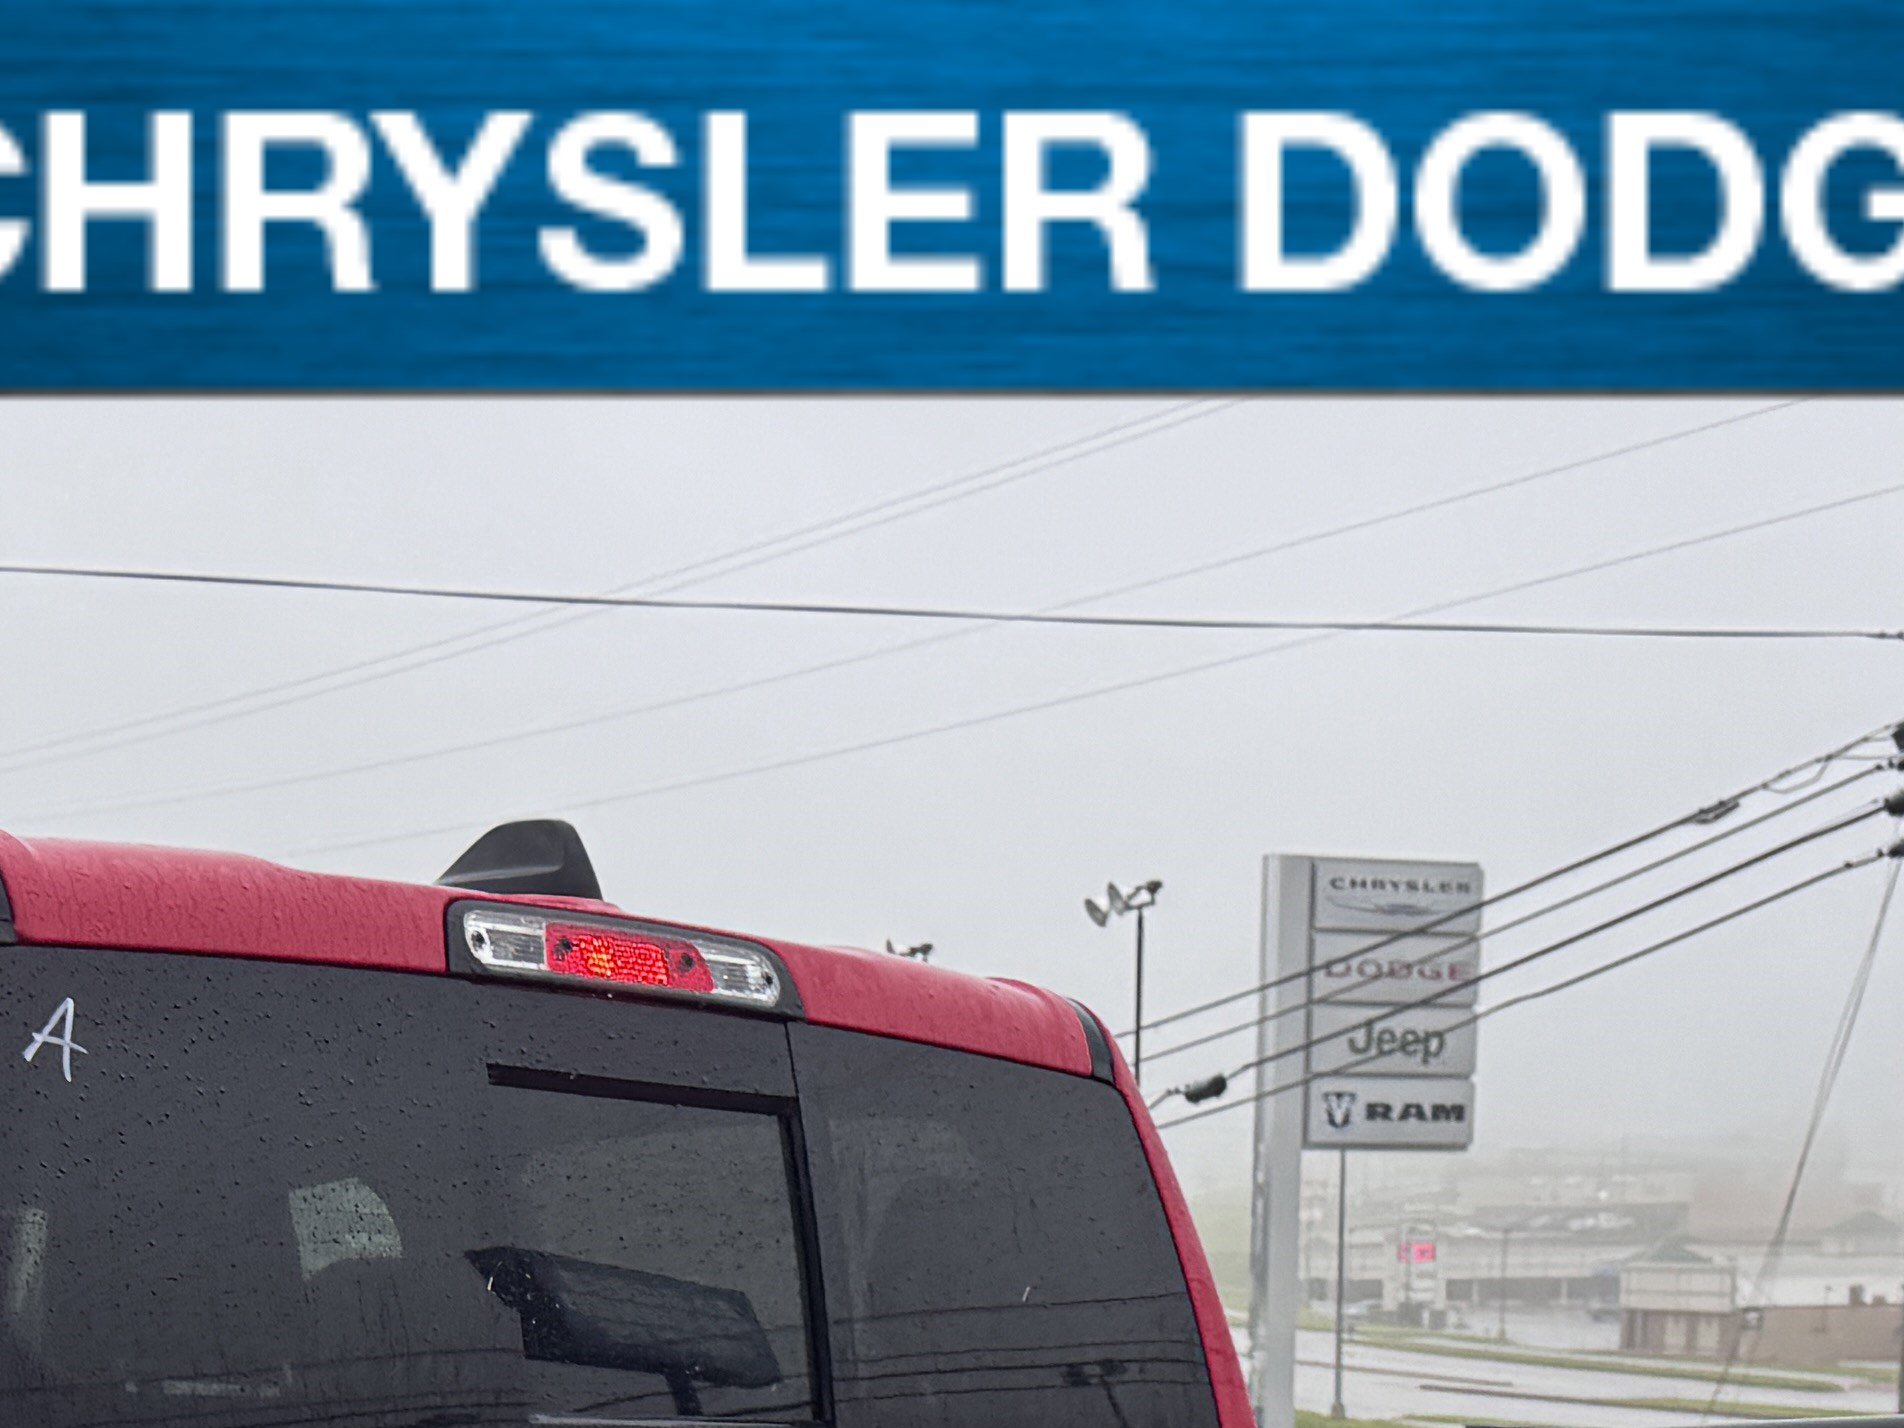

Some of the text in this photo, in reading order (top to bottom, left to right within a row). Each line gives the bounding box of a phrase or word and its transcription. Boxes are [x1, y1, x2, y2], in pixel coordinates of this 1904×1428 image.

[1329, 876, 1472, 894] CHRYSLER
[1324, 958, 1470, 982] DODGE
[22, 996, 90, 1083] A
[1348, 1022, 1446, 1065] Jeep
[1365, 1101, 1467, 1122] RAM
